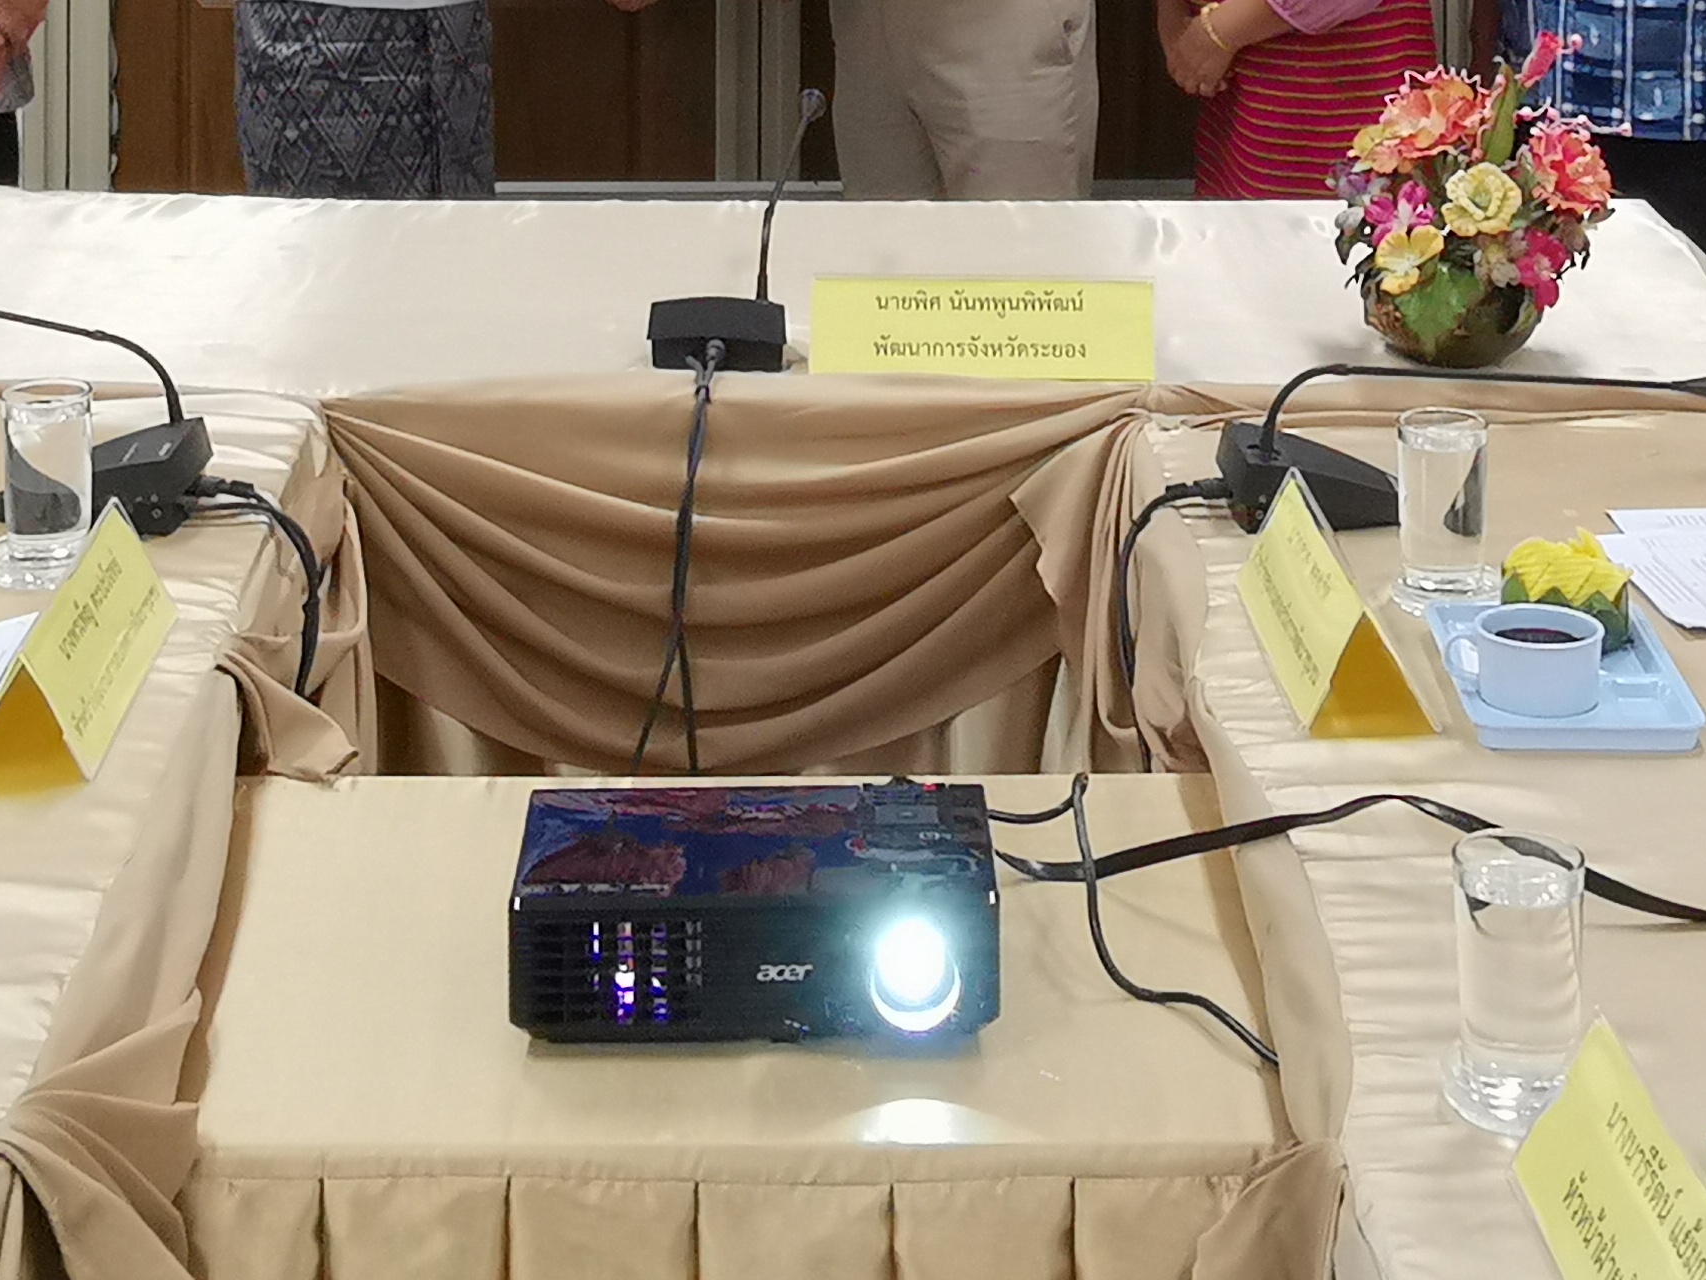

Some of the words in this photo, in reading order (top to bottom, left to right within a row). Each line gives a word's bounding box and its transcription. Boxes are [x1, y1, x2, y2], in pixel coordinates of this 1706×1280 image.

[875, 289, 942, 311] นายพิศ
[949, 289, 1085, 319] นันทพูนพิพัฒน์
[873, 334, 1087, 359] พัฒนาการจังหวัดระยอง
[755, 962, 814, 983] acer
